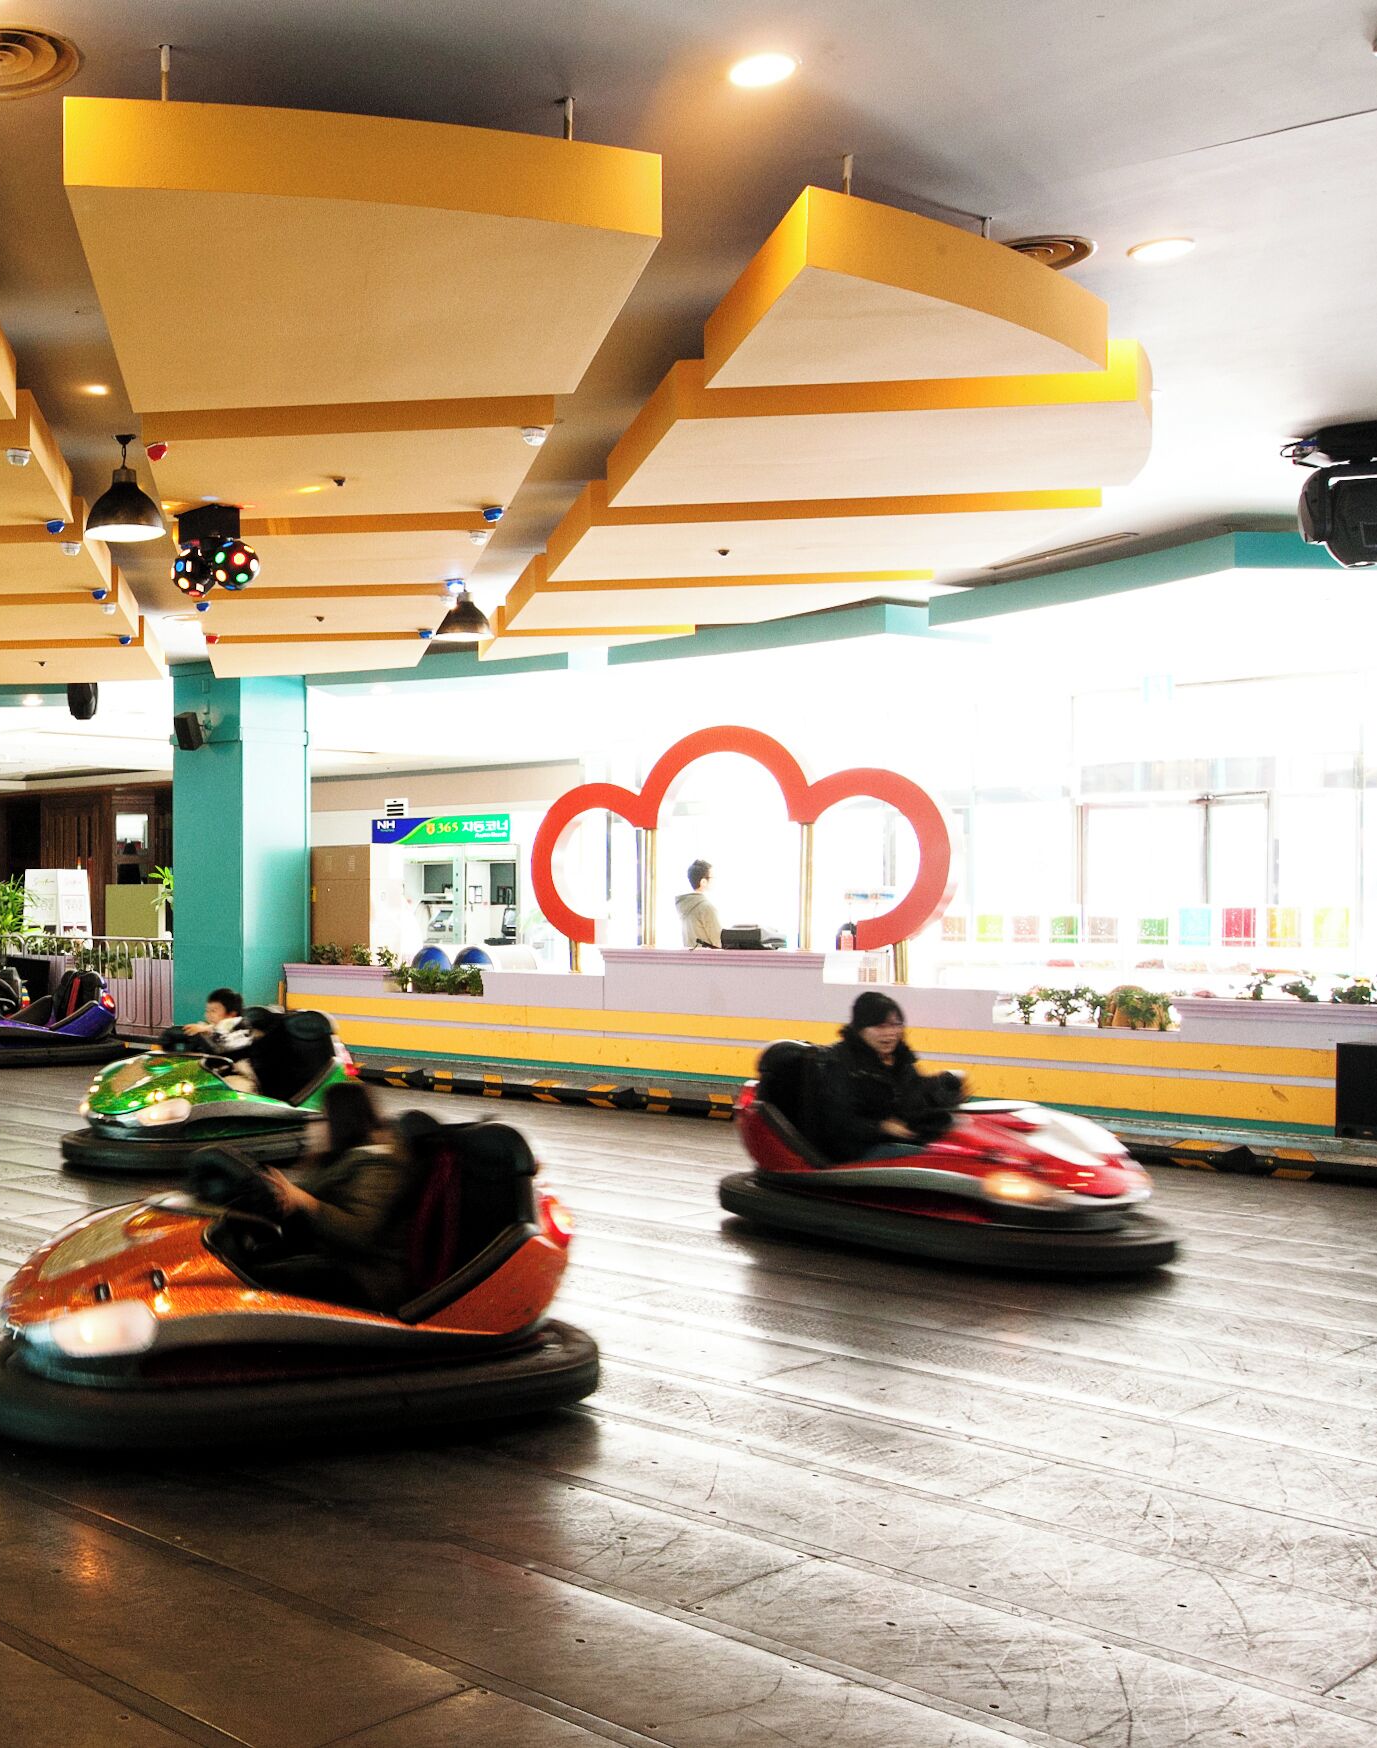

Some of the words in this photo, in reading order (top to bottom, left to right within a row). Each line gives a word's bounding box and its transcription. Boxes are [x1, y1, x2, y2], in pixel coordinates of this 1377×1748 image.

[376, 820, 396, 830] NH
[436, 821, 459, 834] 365
[461, 819, 509, 833] 자동코너
